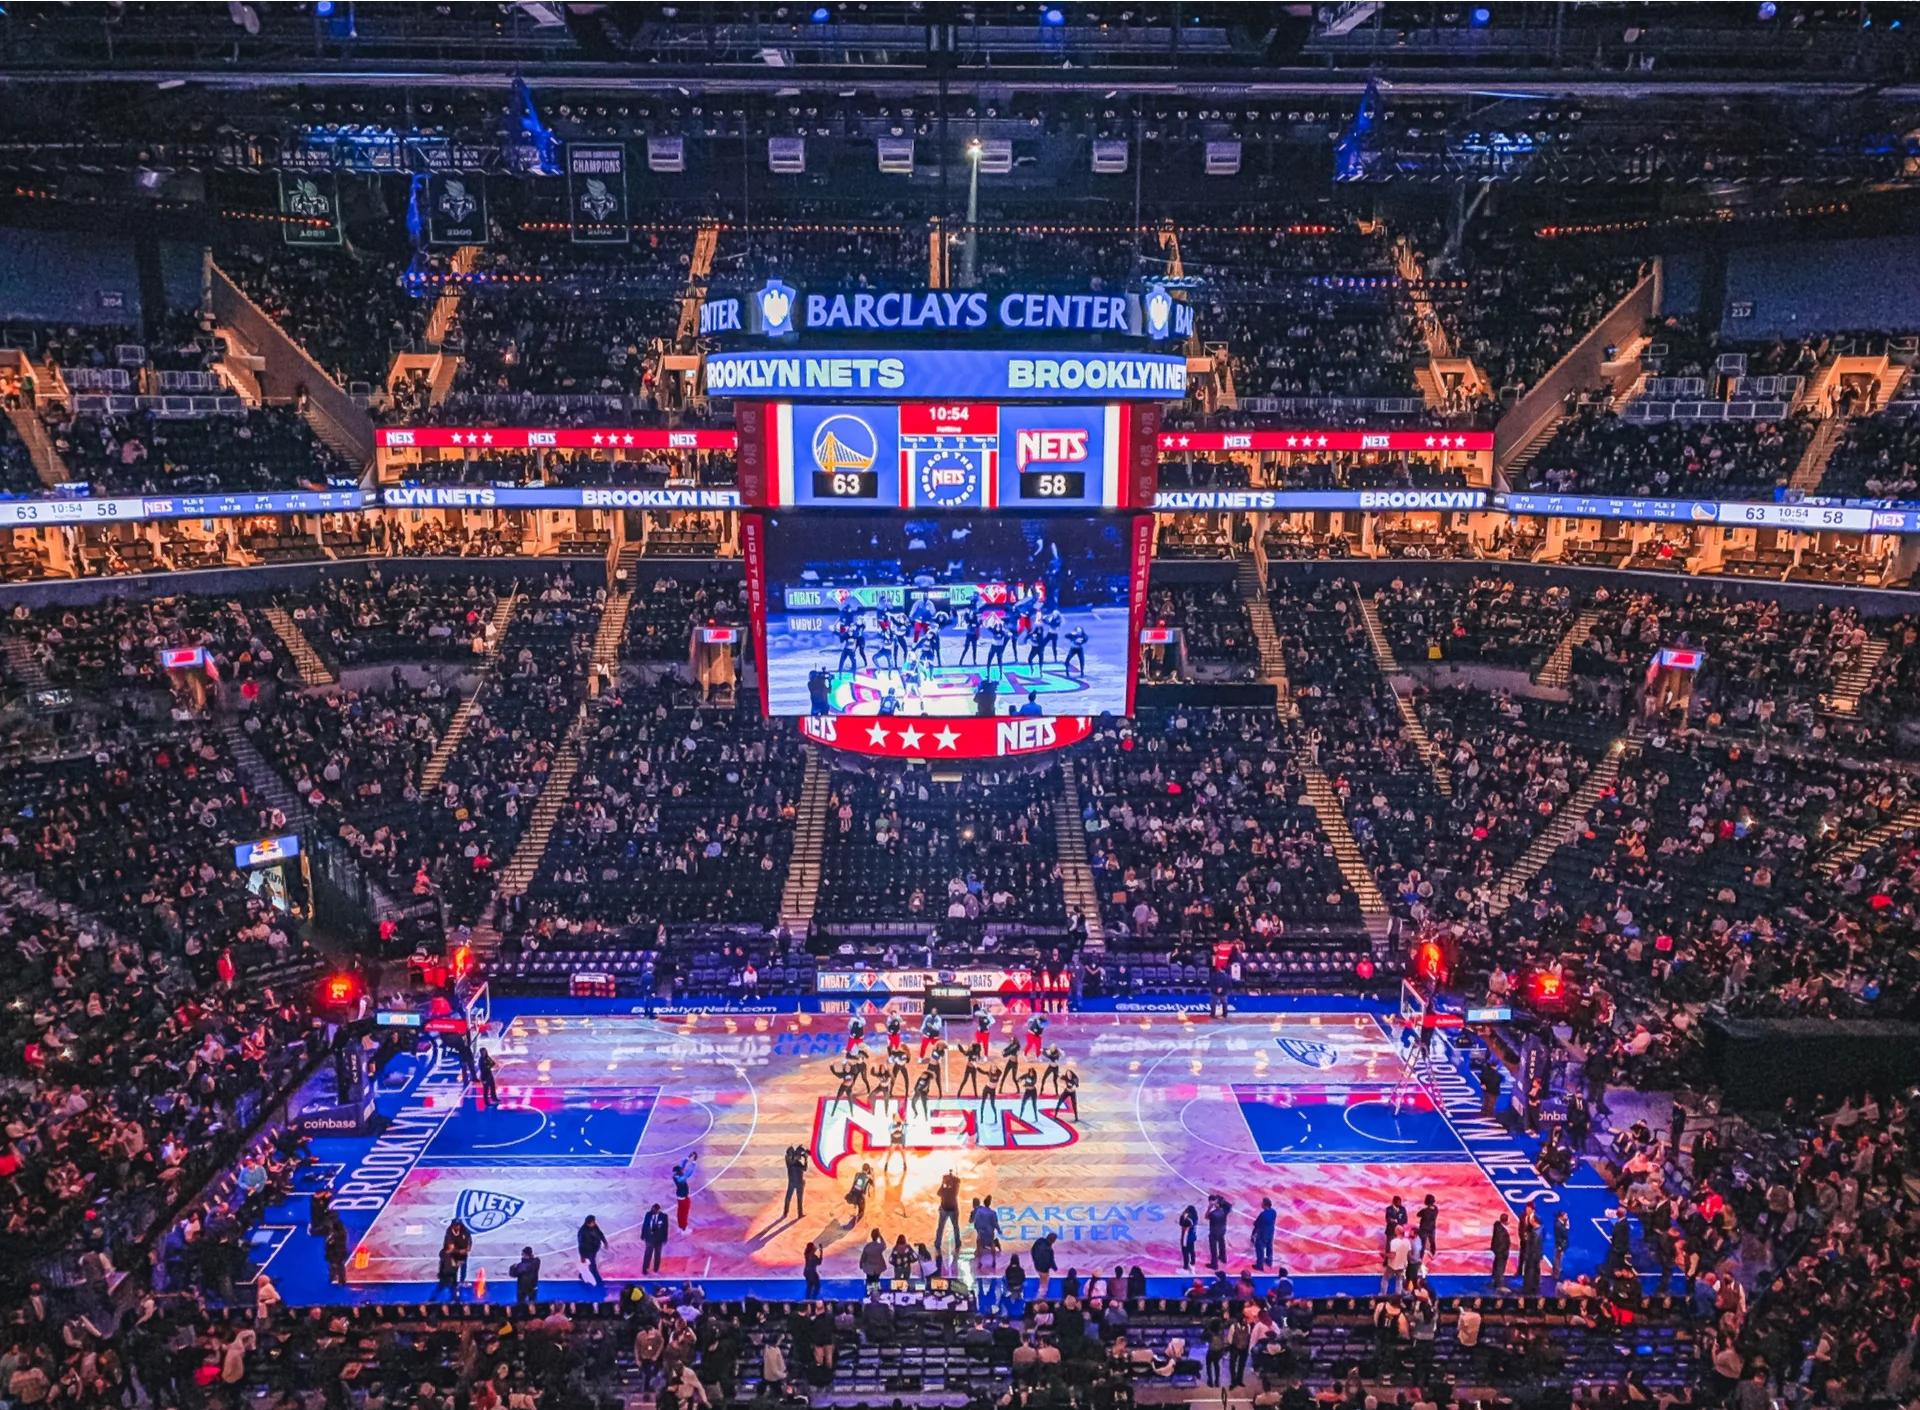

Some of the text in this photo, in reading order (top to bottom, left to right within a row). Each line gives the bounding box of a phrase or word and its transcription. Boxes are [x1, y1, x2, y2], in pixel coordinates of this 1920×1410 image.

[573, 159, 621, 174] CHAMPIONS
[807, 293, 1128, 329] BARCLAYS CENTER
[805, 358, 904, 388] NETS
[1008, 360, 1164, 390] BROOKLYN
[929, 406, 969, 421] 10:54
[387, 432, 415, 445] NETS
[528, 432, 556, 445] NETS
[669, 433, 698, 446] NETS
[1223, 436, 1252, 449] NETS
[1362, 436, 1390, 448] NETS
[1016, 428, 1089, 473] NETS
[832, 474, 860, 493] 63
[932, 469, 966, 490] NETS
[1038, 474, 1066, 493] 58
[437, 489, 496, 505] NETS
[583, 489, 697, 505] BROOKLYN
[1218, 493, 1275, 507] NETS
[1360, 492, 1476, 508] BROOKLYN
[17, 506, 38, 520] 63
[51, 503, 82, 513] 10:54
[97, 503, 117, 516] 58
[143, 501, 173, 517] NETS
[1745, 507, 1765, 520] 63
[1778, 508, 1808, 518] 10:54
[1822, 511, 1843, 524] 58
[1872, 513, 1906, 528] NETS
[746, 524, 761, 614] BIOSTEEL
[1134, 525, 1148, 613] BIOSTEEL
[996, 718, 1057, 756] NETS
[304, 1118, 357, 1129] coinbase
[811, 1095, 1080, 1178] NETS
[328, 1106, 448, 1210] BROOKLYN
[1473, 1150, 1561, 1204] NETS
[468, 1190, 522, 1218] NETS
[998, 1206, 1165, 1222] BARCLAYS
[1000, 1224, 1136, 1241] CENTER
